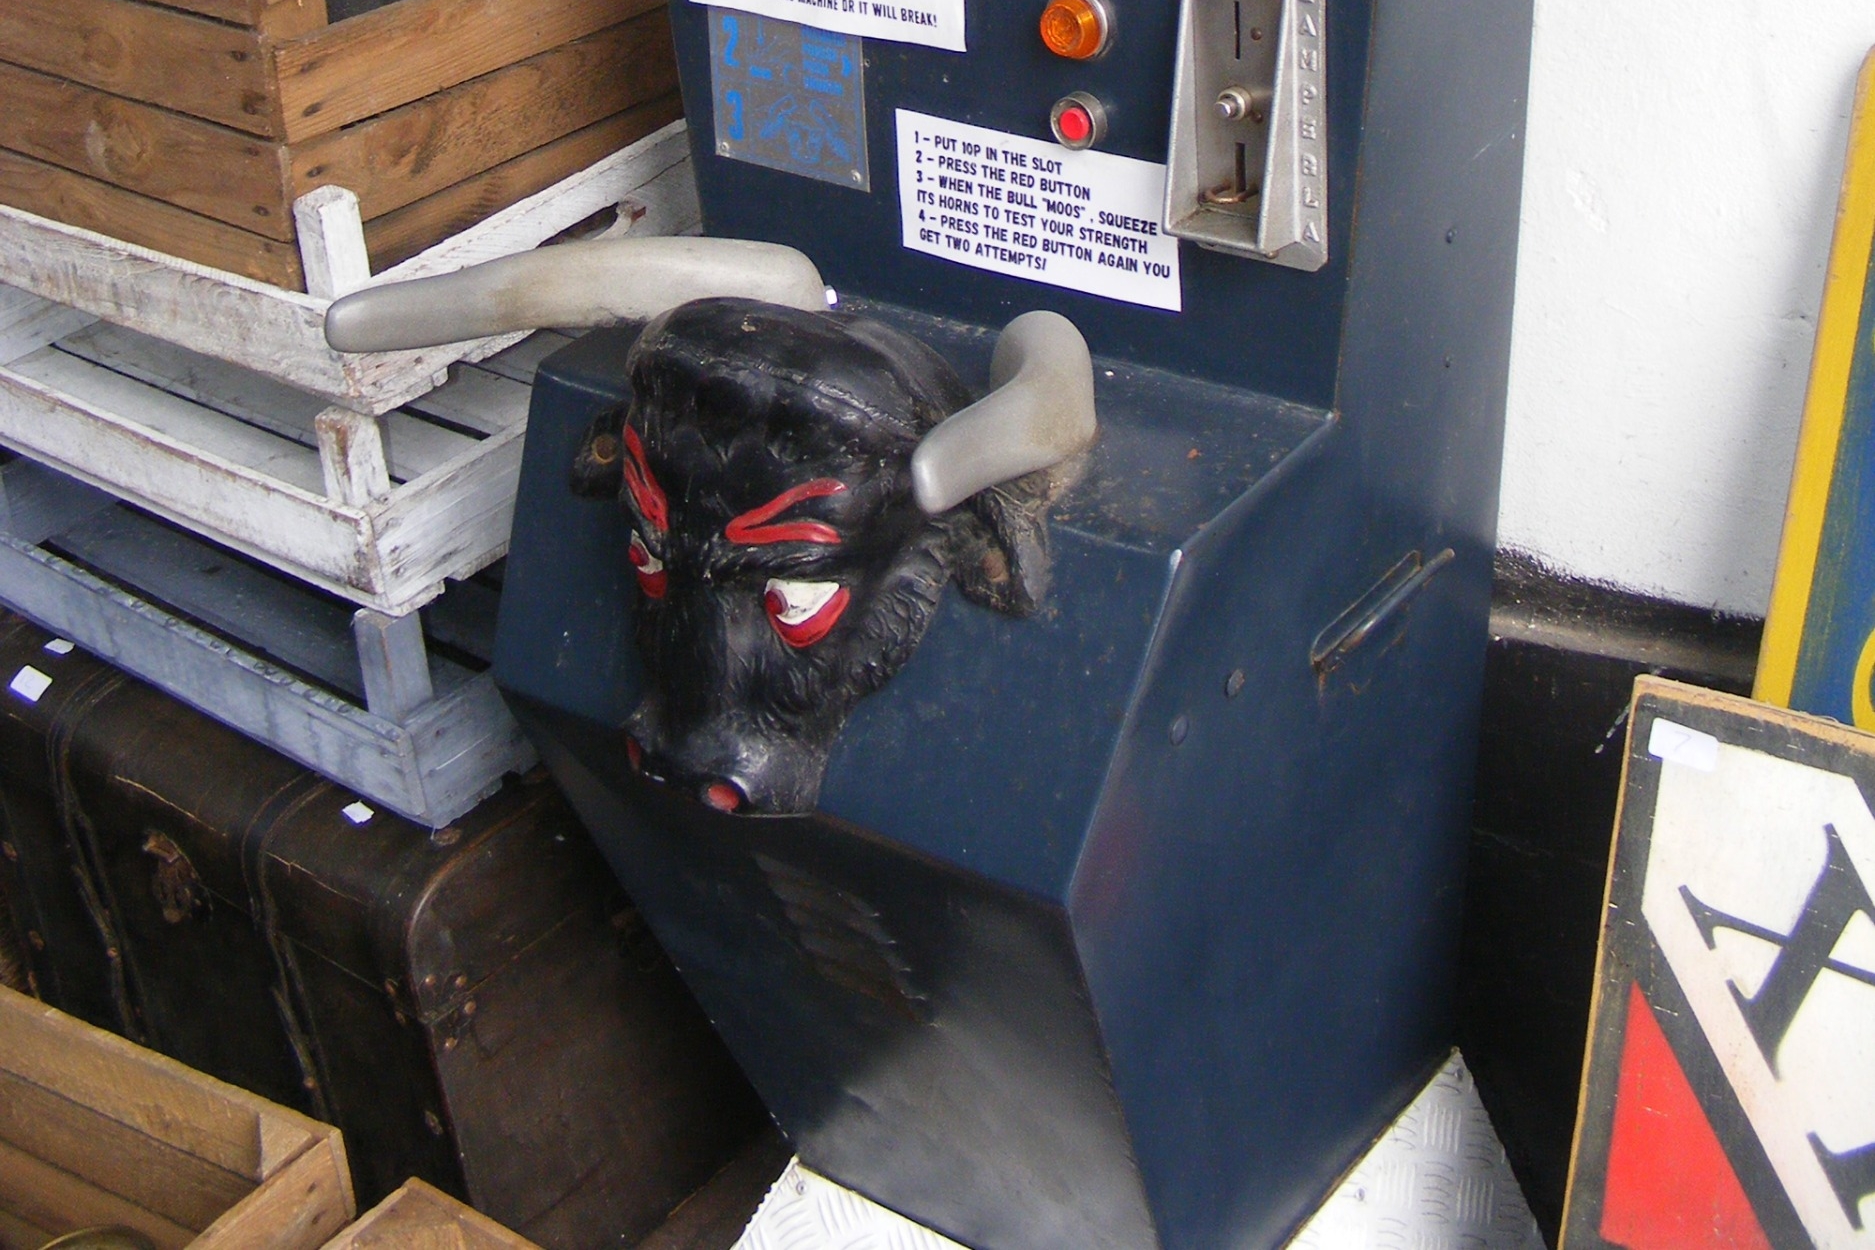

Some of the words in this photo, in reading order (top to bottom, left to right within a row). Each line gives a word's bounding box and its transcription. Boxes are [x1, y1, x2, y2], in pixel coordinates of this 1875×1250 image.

[859, 1, 868, 15] IT
[872, 3, 897, 20] WILL
[901, 8, 938, 28] BREAK!
[722, 15, 740, 68] 2
[914, 131, 919, 143] 1
[935, 136, 956, 151] PUT
[962, 141, 981, 156] 10P
[986, 146, 997, 161] IN
[1002, 151, 1026, 167] THE
[1032, 157, 1062, 175] SLOT
[916, 150, 922, 163] 2
[938, 156, 977, 176] PRESS
[981, 165, 1005, 181] THE
[1011, 172, 1034, 188] RED
[1040, 179, 1090, 200] BUTTON
[916, 170, 923, 182] 3
[939, 175, 973, 194] WHEN
[978, 184, 1002, 200] THE
[1008, 191, 1037, 209] BULL
[1099, 211, 1158, 236] SQUEEZE
[917, 189, 934, 205] ITS
[939, 194, 978, 215] HORNS
[984, 204, 1000, 220] TO
[1004, 210, 1036, 228] TEST
[1040, 217, 1074, 237] YOUR
[1080, 227, 1148, 254] STRENGTH
[919, 209, 925, 222] 4
[941, 215, 978, 235] PRESS
[984, 224, 1008, 242] THE
[1012, 231, 1037, 248] RED
[1042, 239, 1092, 262] BUTTON
[1098, 251, 1138, 273] AGAIN
[1143, 260, 1170, 279] YOU
[920, 228, 941, 244] GET
[946, 235, 970, 252] TWO
[975, 242, 1046, 270] ATTEMPTS!
